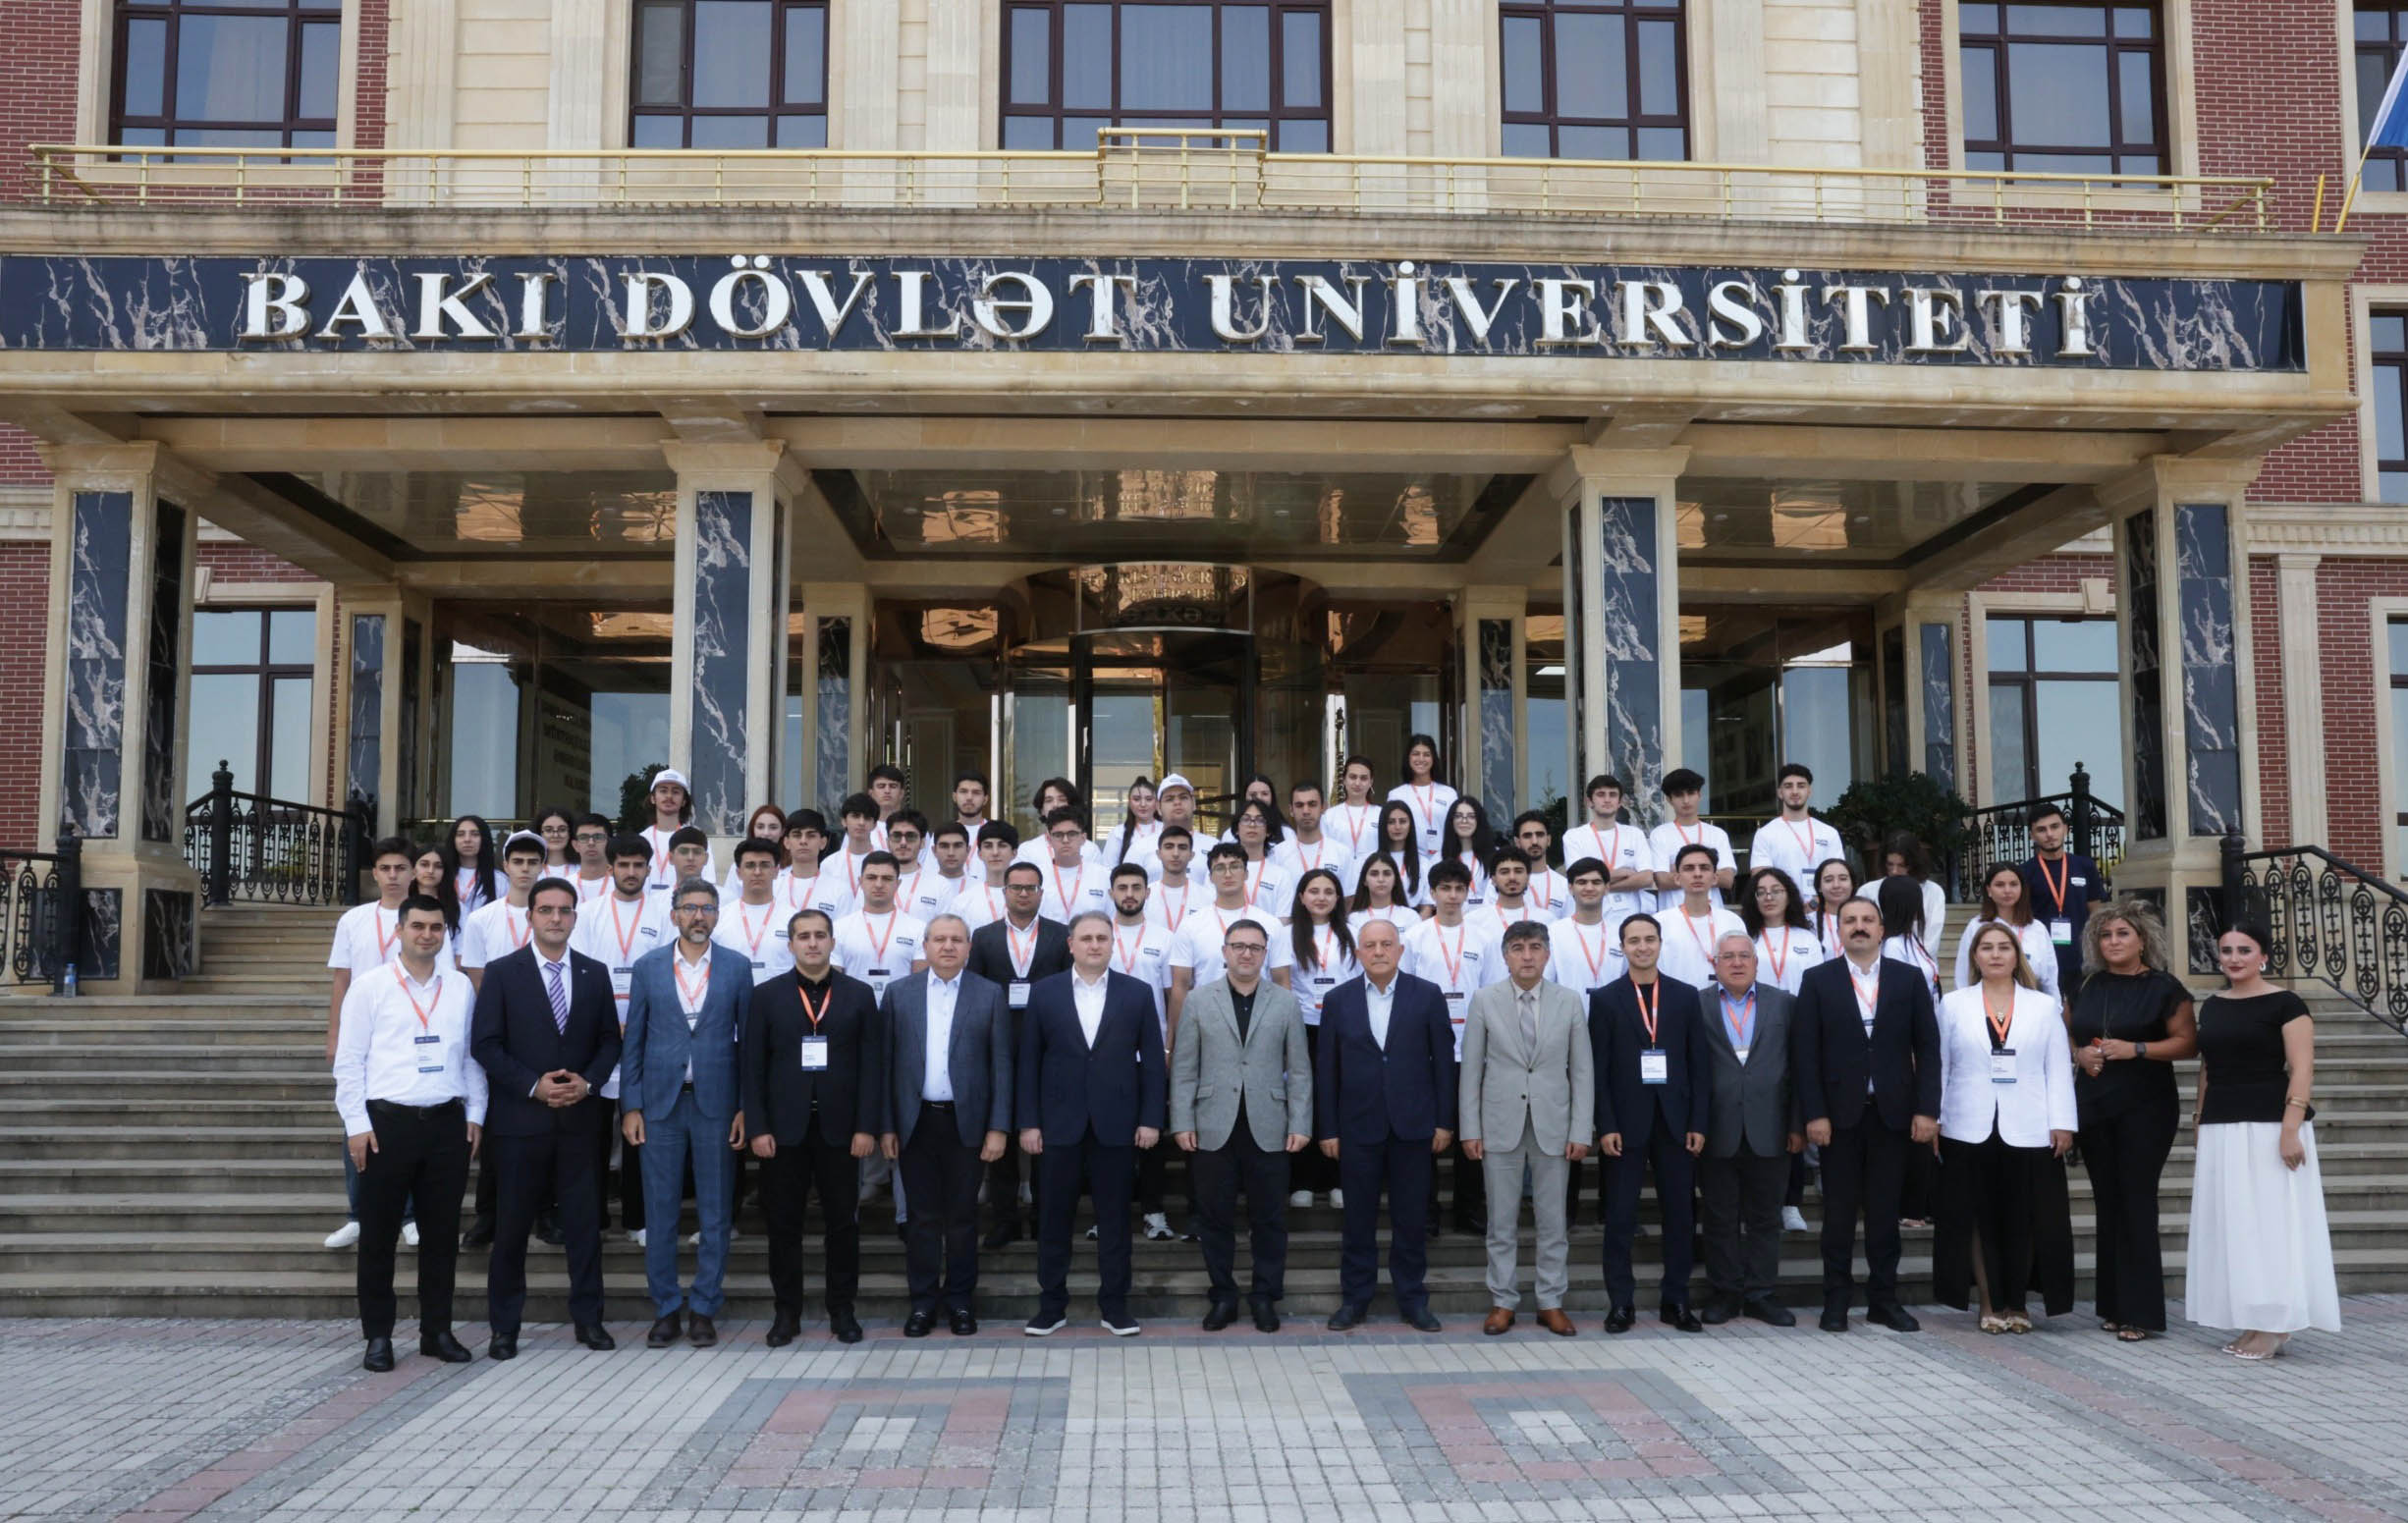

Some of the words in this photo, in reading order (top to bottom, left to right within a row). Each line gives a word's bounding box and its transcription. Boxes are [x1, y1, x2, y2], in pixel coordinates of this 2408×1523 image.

[238, 273, 558, 341] BAKI
[618, 254, 1137, 341] DÖVLƏT
[1203, 260, 2098, 358] UNİVERSİTETİ
